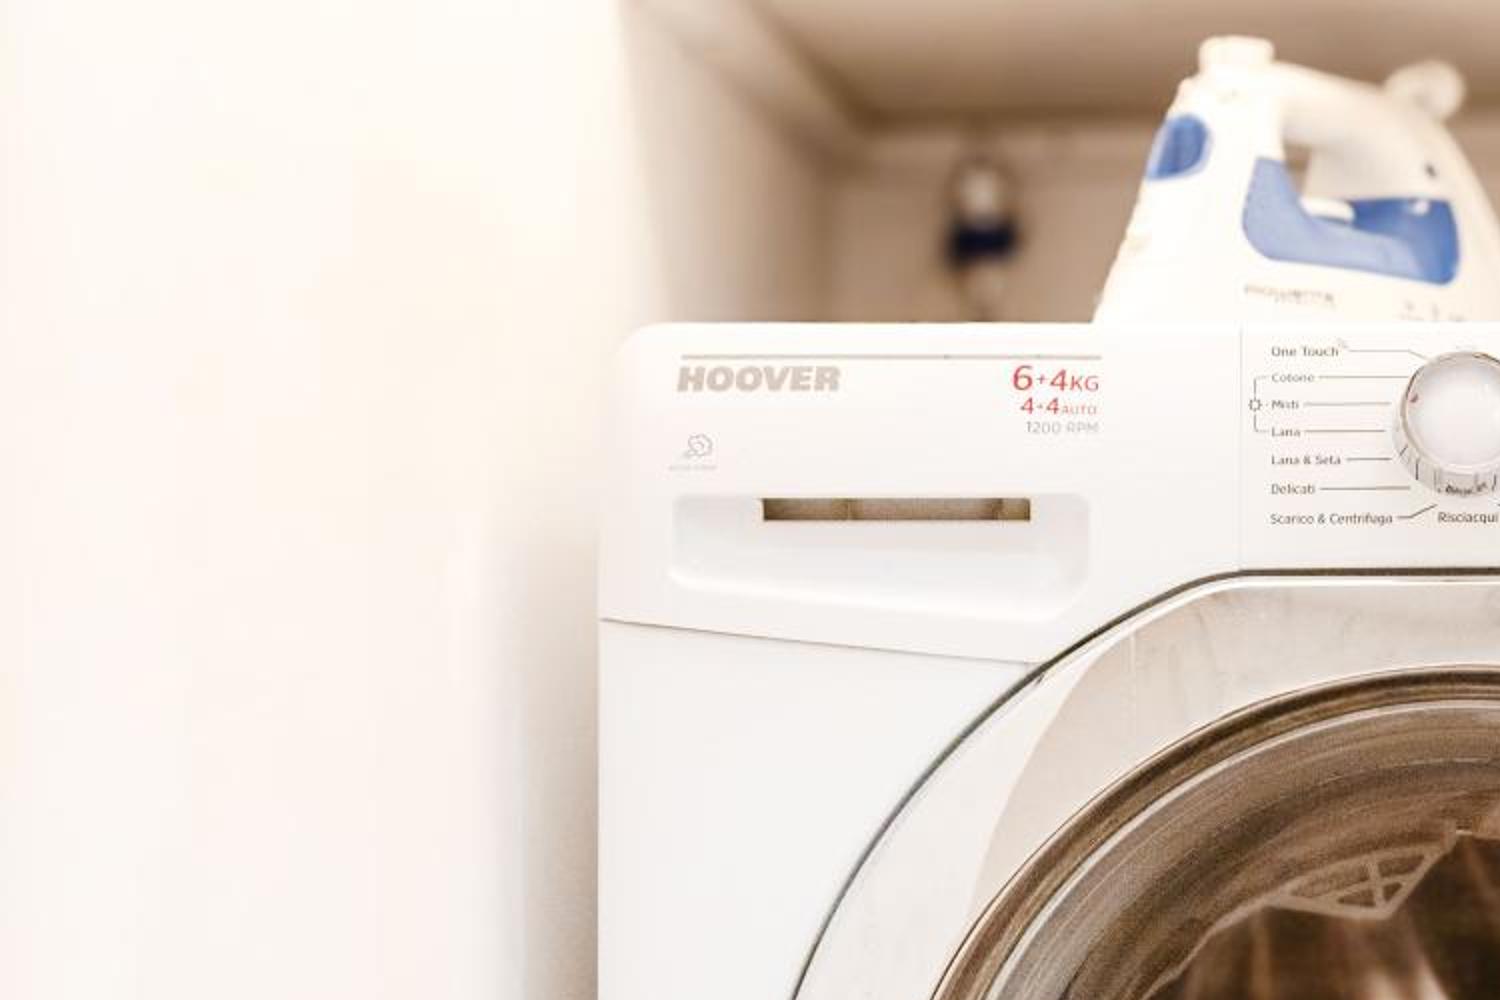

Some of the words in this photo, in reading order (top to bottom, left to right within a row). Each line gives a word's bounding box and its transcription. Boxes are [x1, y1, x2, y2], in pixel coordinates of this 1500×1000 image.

[1271, 346, 1297, 357] One
[1300, 345, 1340, 357] Touch
[677, 366, 841, 392] HOOVER
[1271, 372, 1315, 383] Cotone
[1271, 399, 1300, 411] Misti
[1026, 421, 1061, 434] 1200
[1066, 421, 1100, 434] RPM
[1271, 427, 1302, 438] Lana
[1271, 454, 1301, 466] Lana
[1303, 454, 1312, 466] &
[1315, 454, 1342, 466] Seta
[1271, 483, 1316, 495] Delicati
[1270, 512, 1315, 525] Scarico
[1317, 512, 1327, 525] &
[1329, 511, 1393, 527] Centrifuga
[1438, 511, 1498, 524] Risciacqui
